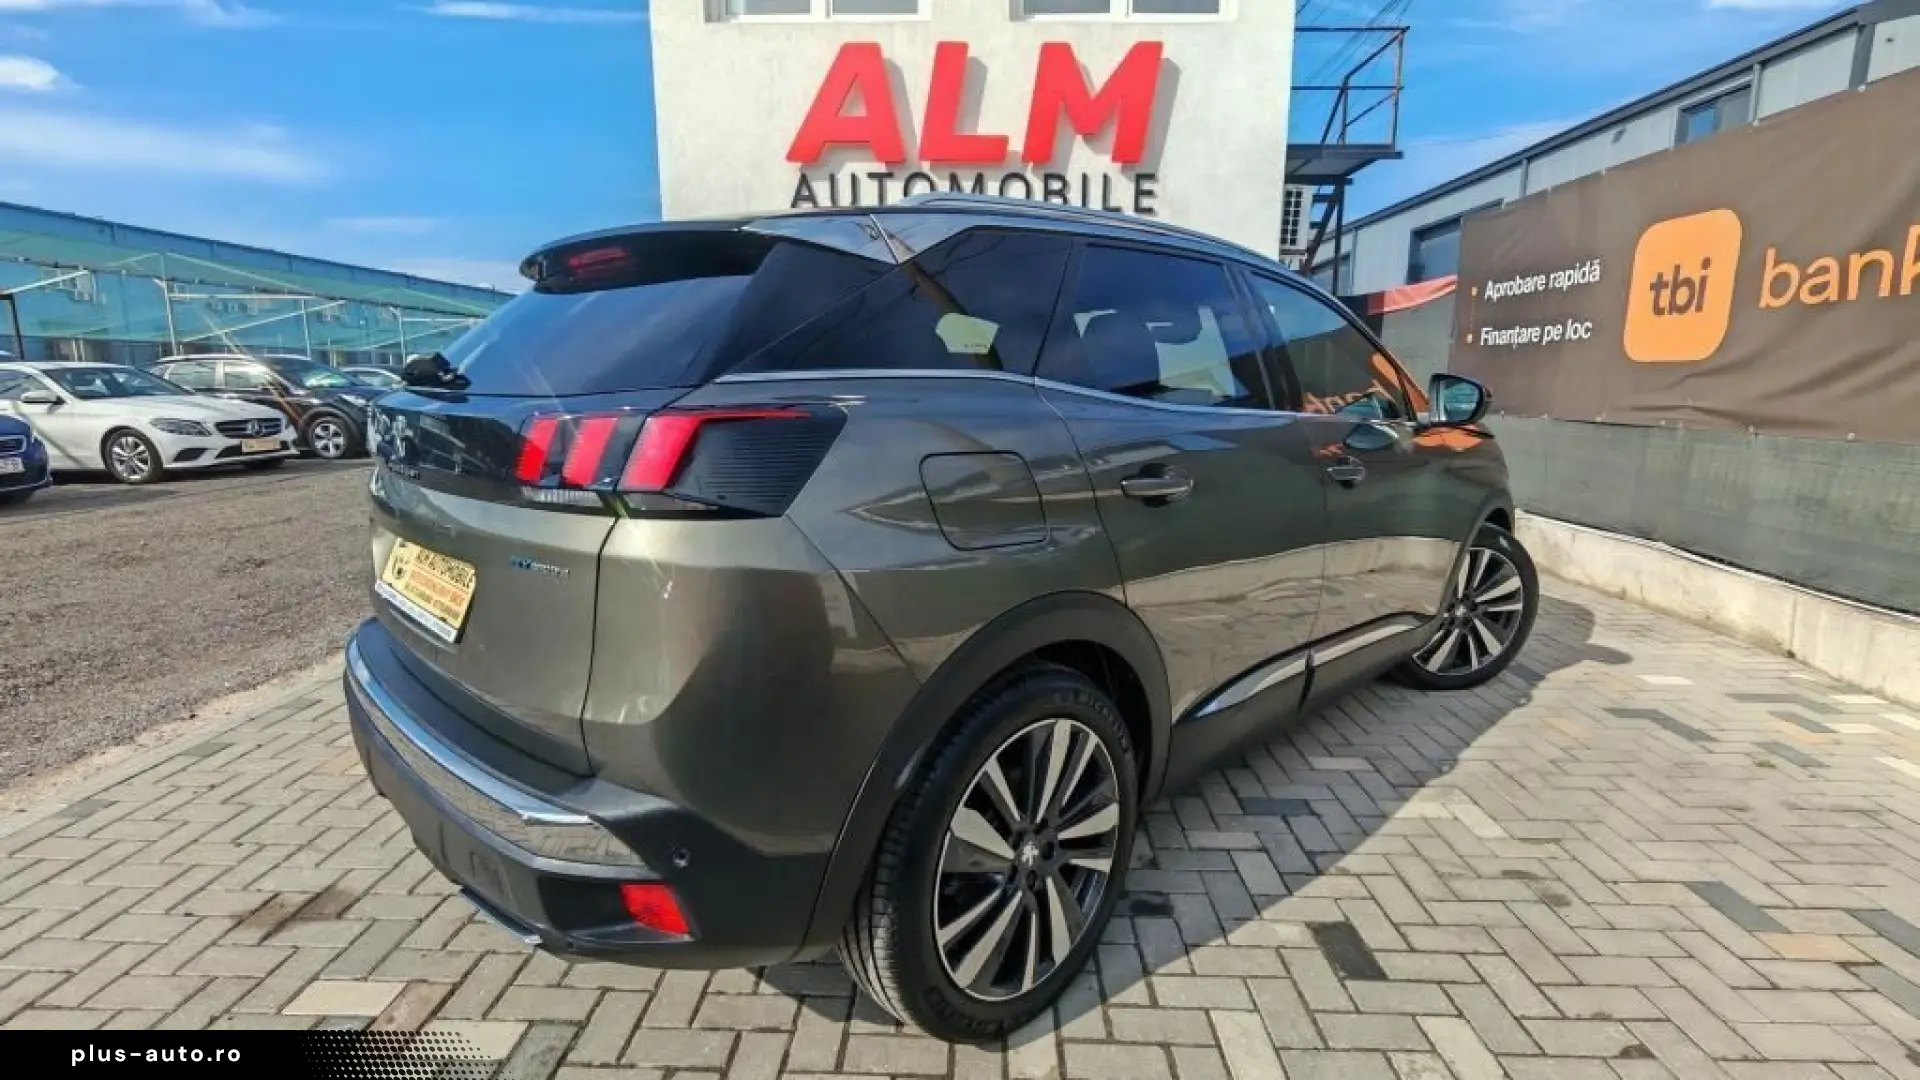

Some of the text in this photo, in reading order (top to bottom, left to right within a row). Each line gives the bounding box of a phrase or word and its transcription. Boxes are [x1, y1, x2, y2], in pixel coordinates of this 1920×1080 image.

[785, 40, 1164, 164] ALM
[790, 171, 1157, 213] AUTOMOBILE
[1484, 258, 1601, 302] Aprobare rapidă
[1649, 256, 1711, 316] tbi
[1542, 323, 1563, 346] pe
[1565, 318, 1593, 341] loc
